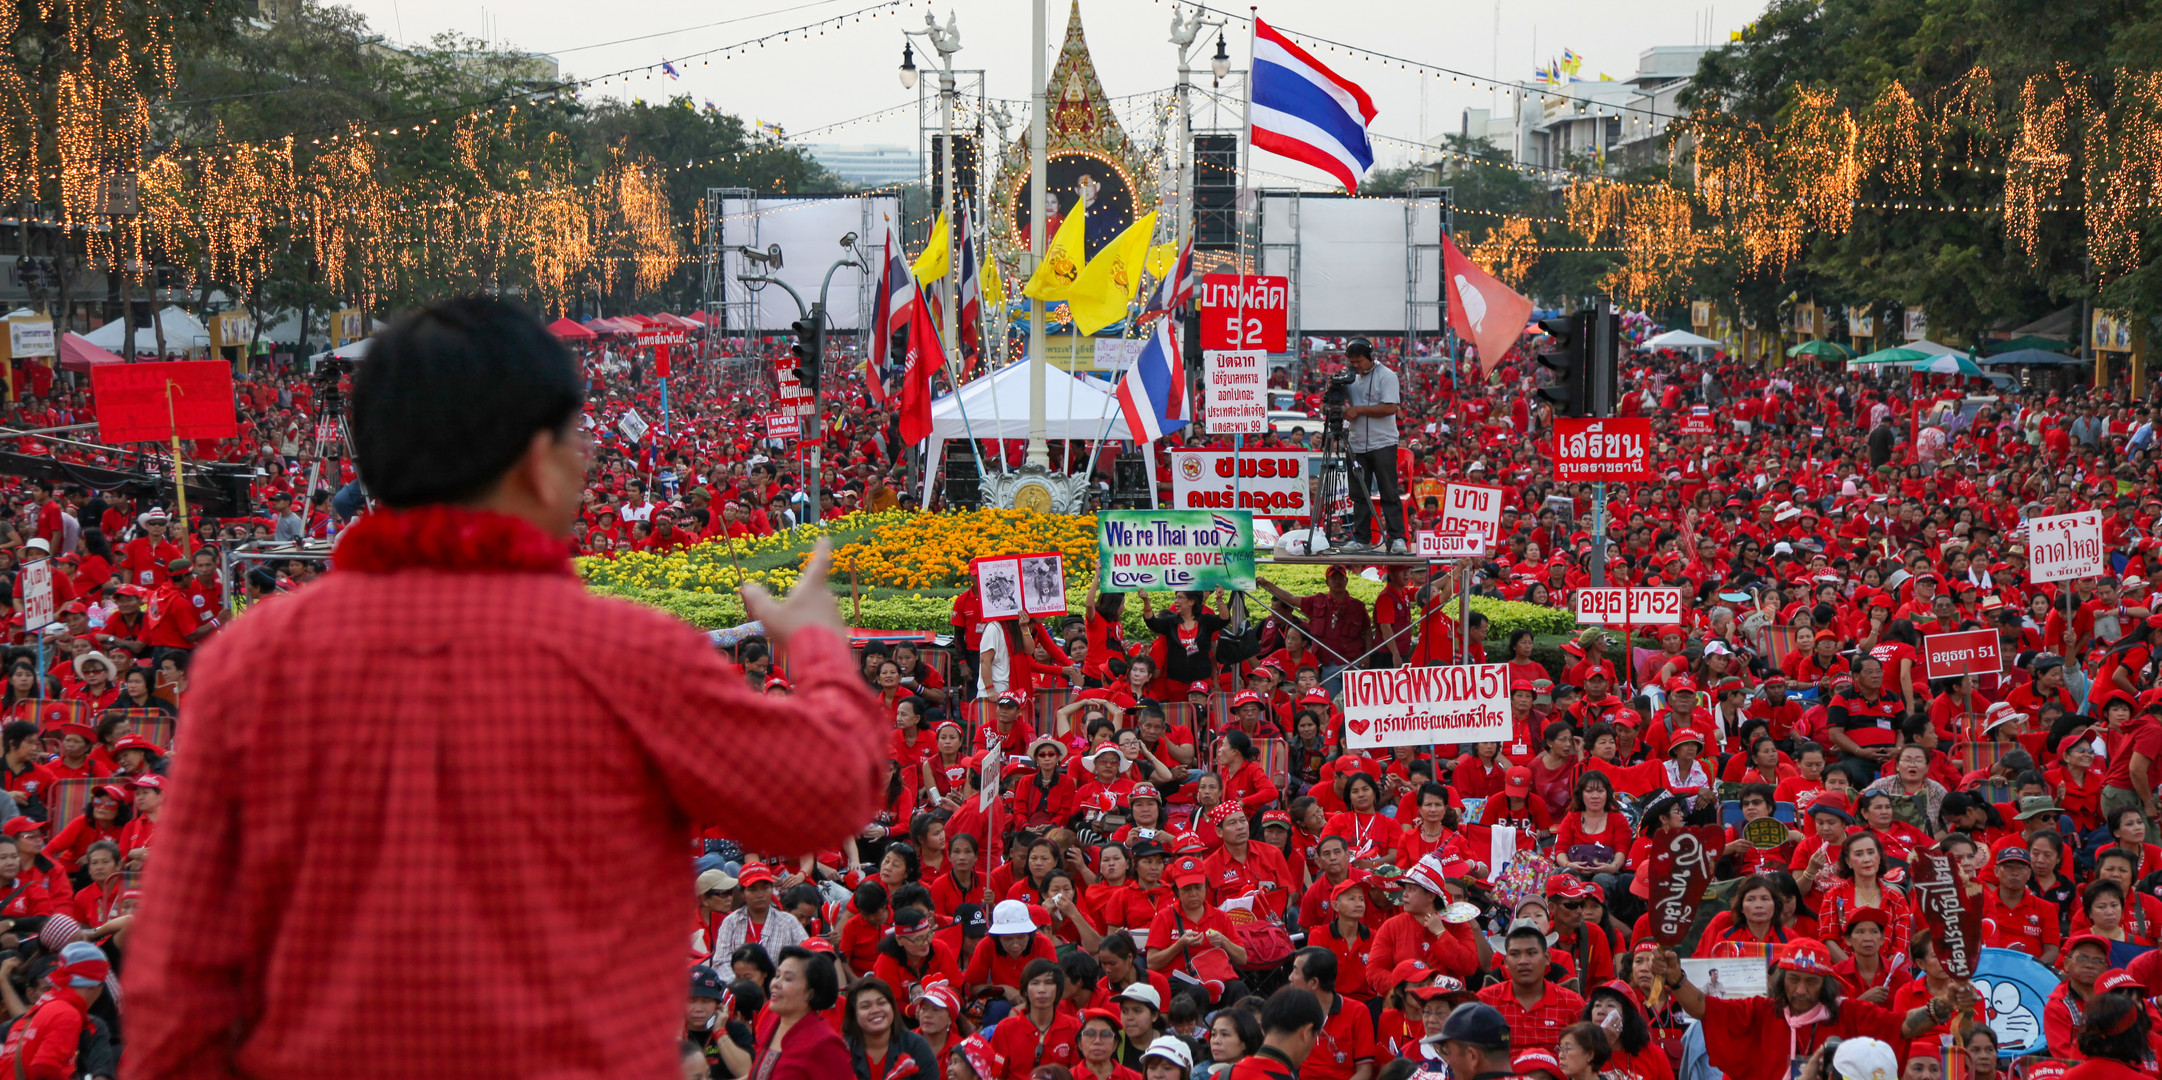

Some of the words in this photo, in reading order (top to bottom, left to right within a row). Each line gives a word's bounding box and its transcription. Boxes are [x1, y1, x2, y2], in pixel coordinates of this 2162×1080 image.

[1201, 278, 1285, 310] บางพลัด
[1226, 317, 1263, 345] 52
[1216, 353, 1256, 368] ปิดฉาก
[1212, 370, 1259, 386] ไอ้รัฐบาลทรราช
[1208, 403, 1266, 419] ประเทศจะได้เจริญ
[1250, 420, 1261, 433] 99
[1559, 421, 1645, 459] เสรีชน
[1215, 456, 1300, 479] ชมรม
[1559, 459, 1644, 479] อุบลราชธานี
[1187, 484, 1305, 514] คนรักอุดร
[1454, 488, 1489, 512] บาง
[1104, 520, 1153, 548] We're
[1151, 520, 1188, 548] Thai
[2036, 516, 2096, 532] แดง
[2034, 527, 2100, 565] ลาดใหญ่
[1113, 552, 1131, 567] NO
[1111, 570, 1158, 588] Love
[1164, 568, 1196, 587] Lie
[1931, 648, 1975, 668] อยุธยา
[1978, 645, 1996, 659] 51
[1498, 817, 1531, 829] RED
